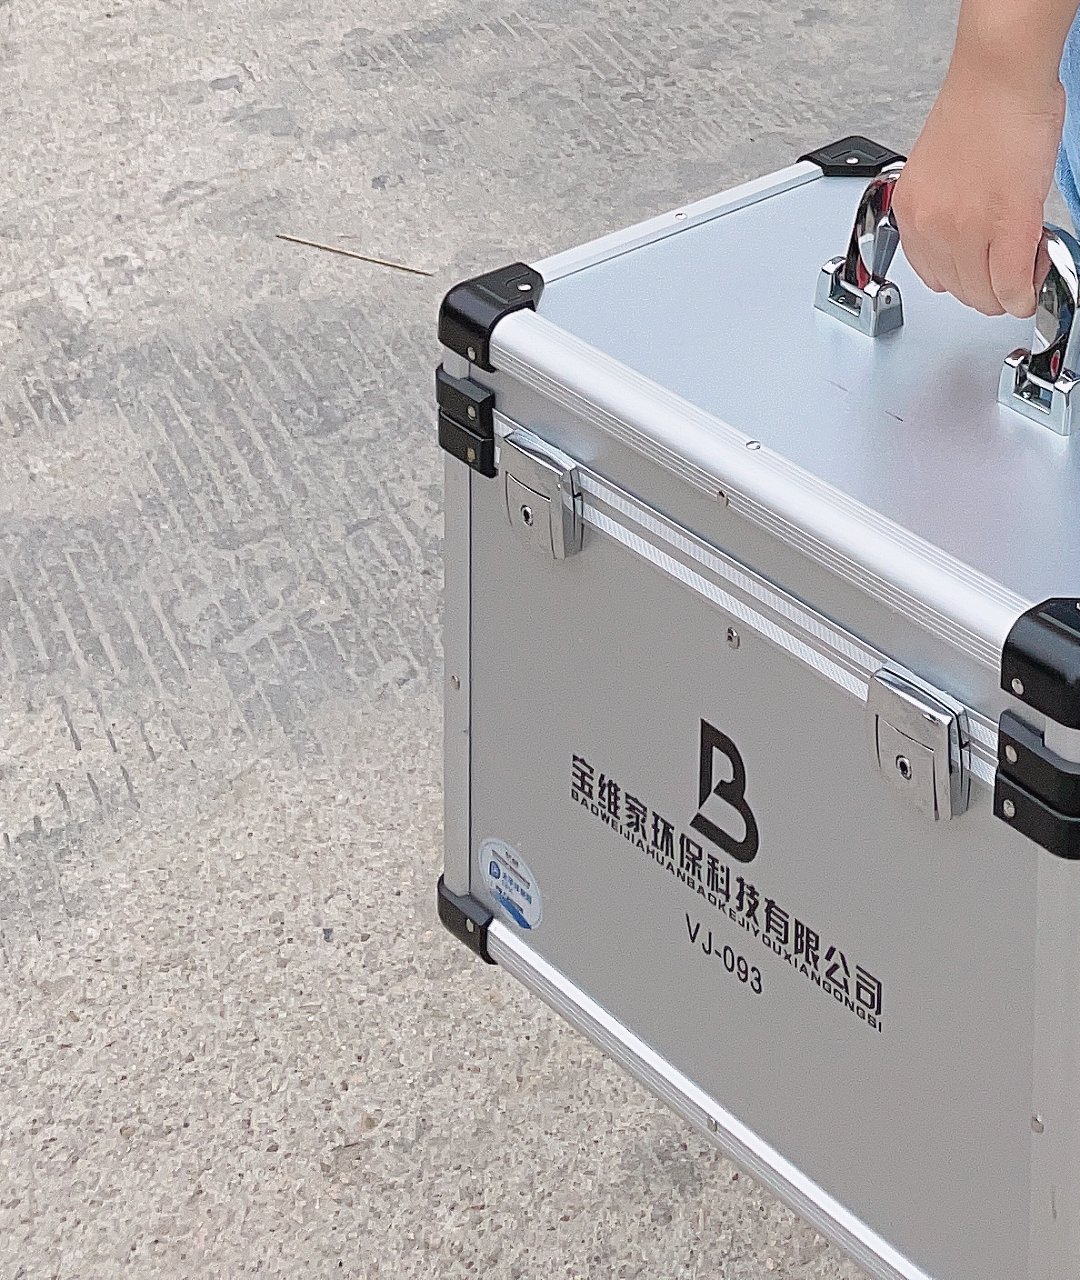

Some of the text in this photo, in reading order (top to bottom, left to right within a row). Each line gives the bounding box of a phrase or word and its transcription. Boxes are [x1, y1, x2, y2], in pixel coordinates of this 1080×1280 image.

[571, 753, 883, 1016] 宝维家环保科技有限公司
[685, 912, 763, 995] VJ-093
